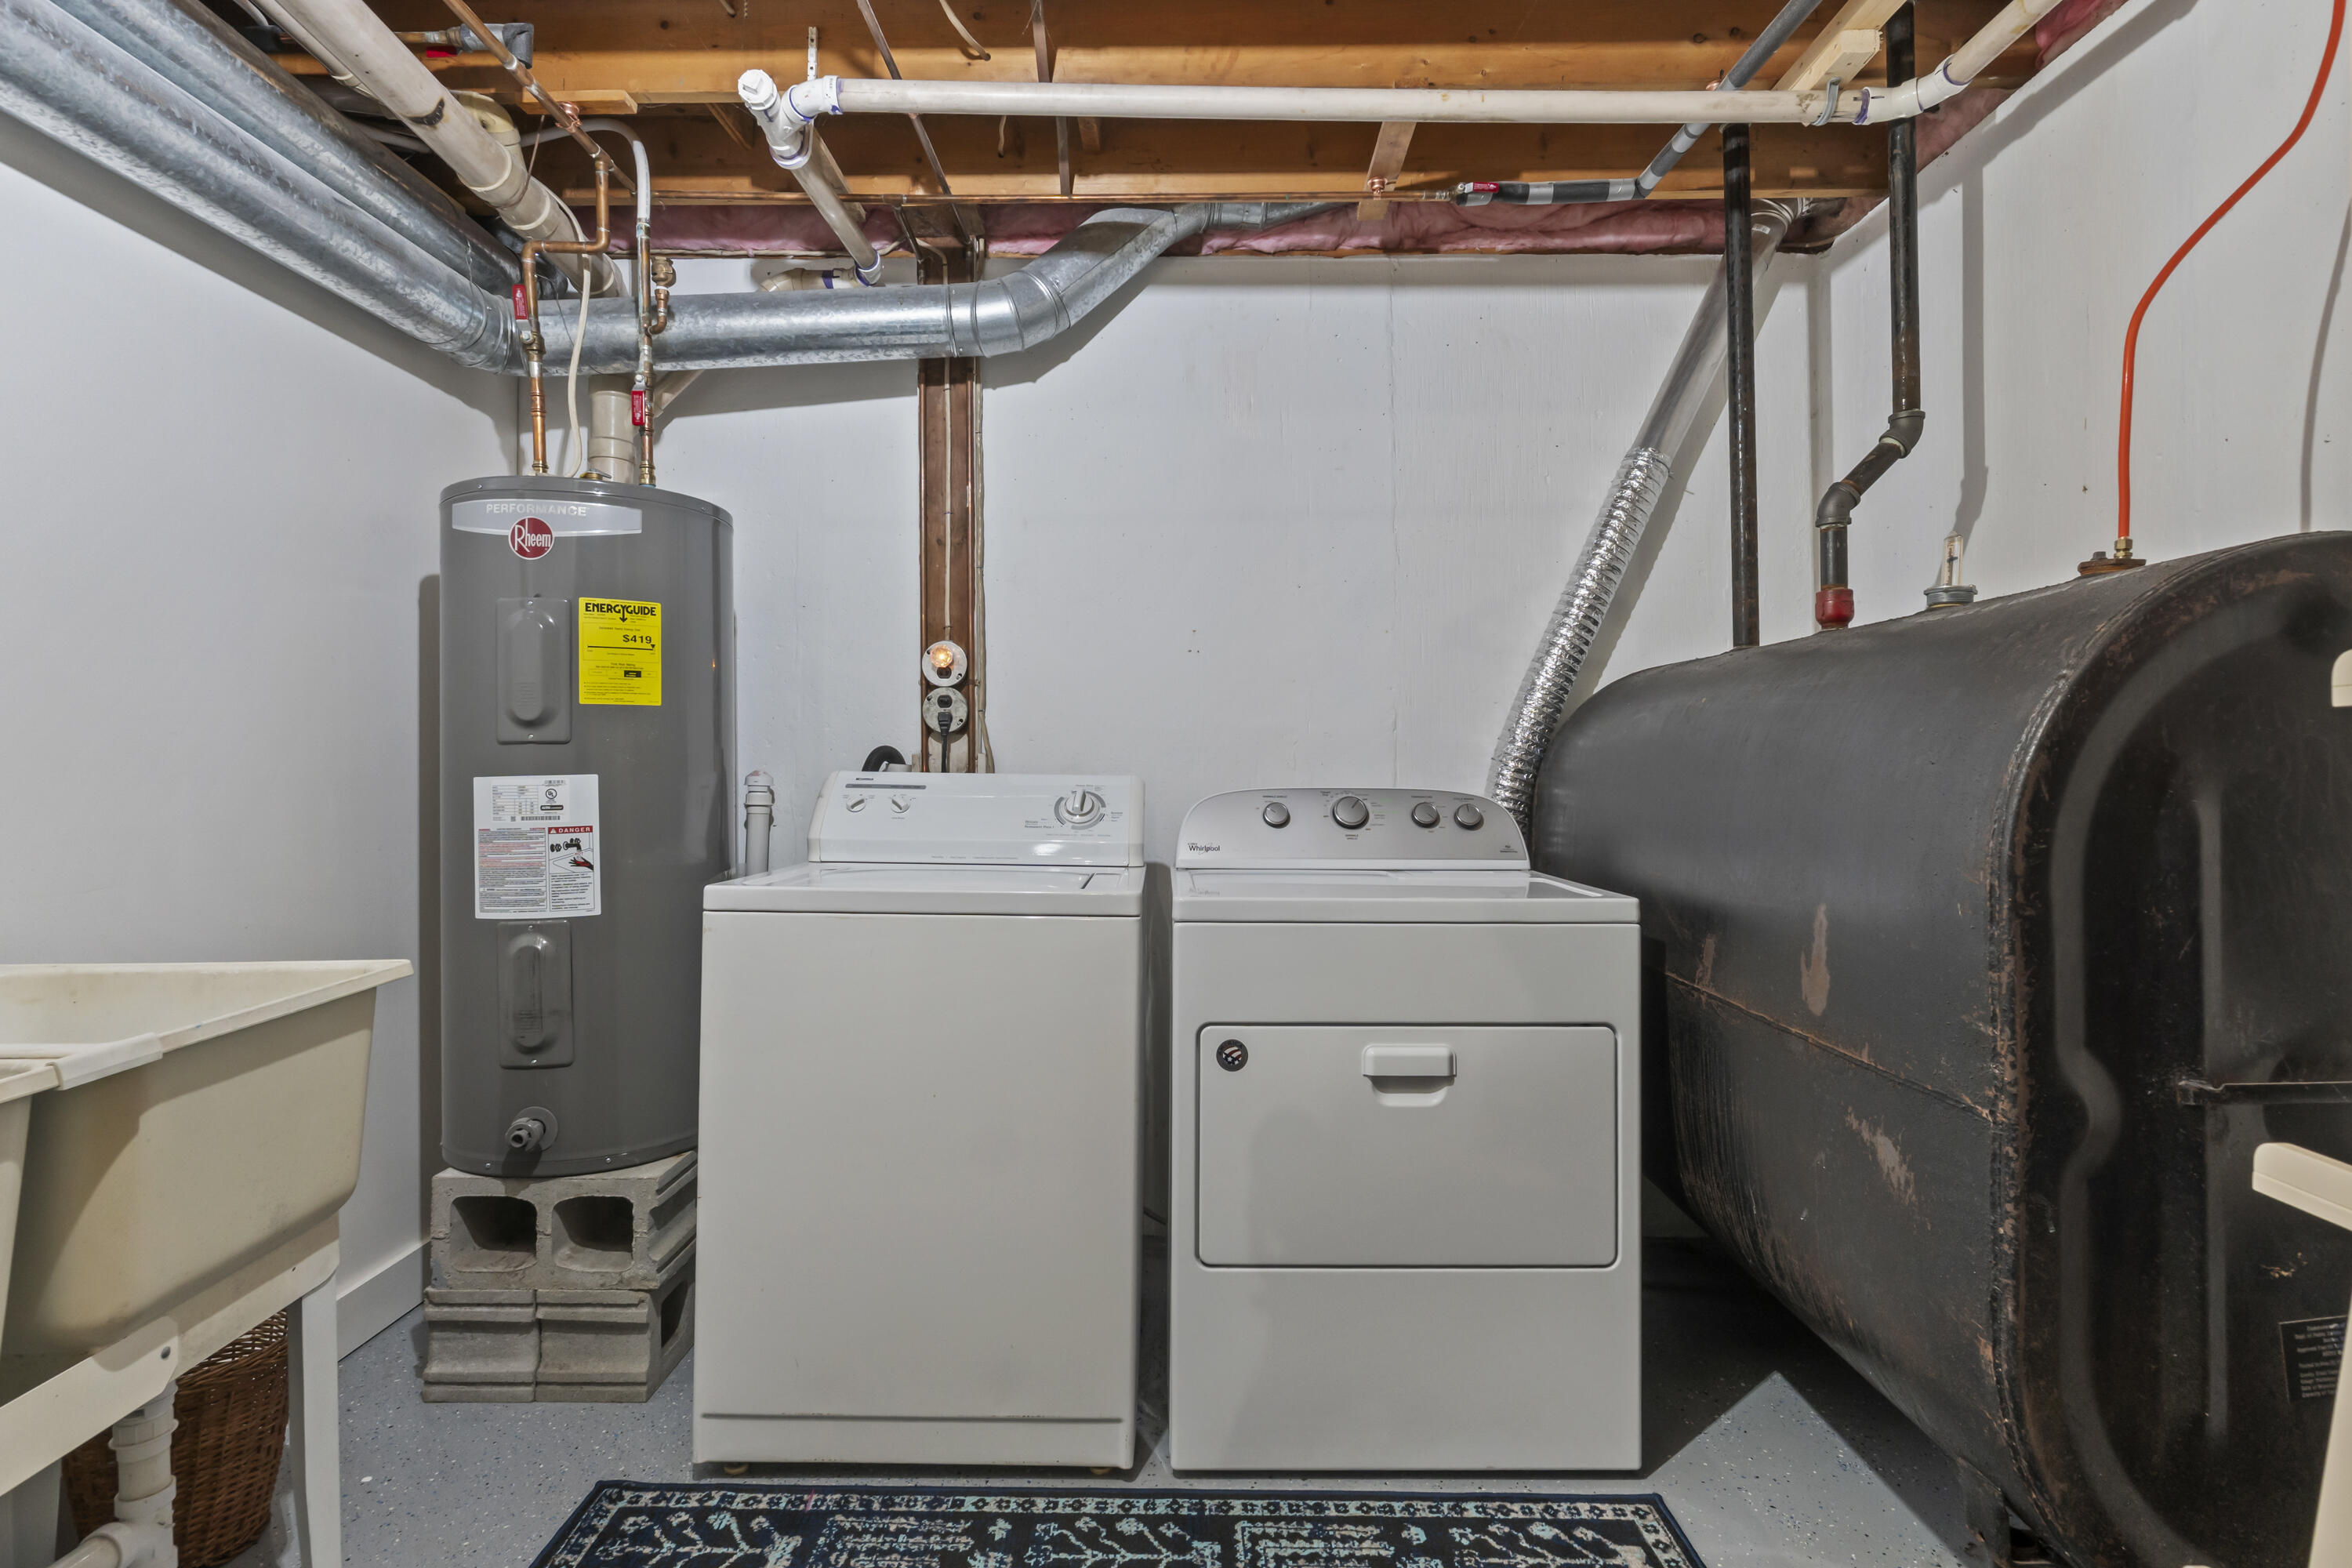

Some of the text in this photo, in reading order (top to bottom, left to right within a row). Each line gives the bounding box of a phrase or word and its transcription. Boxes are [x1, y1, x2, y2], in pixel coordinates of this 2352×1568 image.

[486, 503, 586, 516] PERFORMANCE
[514, 518, 551, 552] Rheem
[585, 602, 656, 616] ENERGYGUIDE
[622, 634, 652, 644] $419
